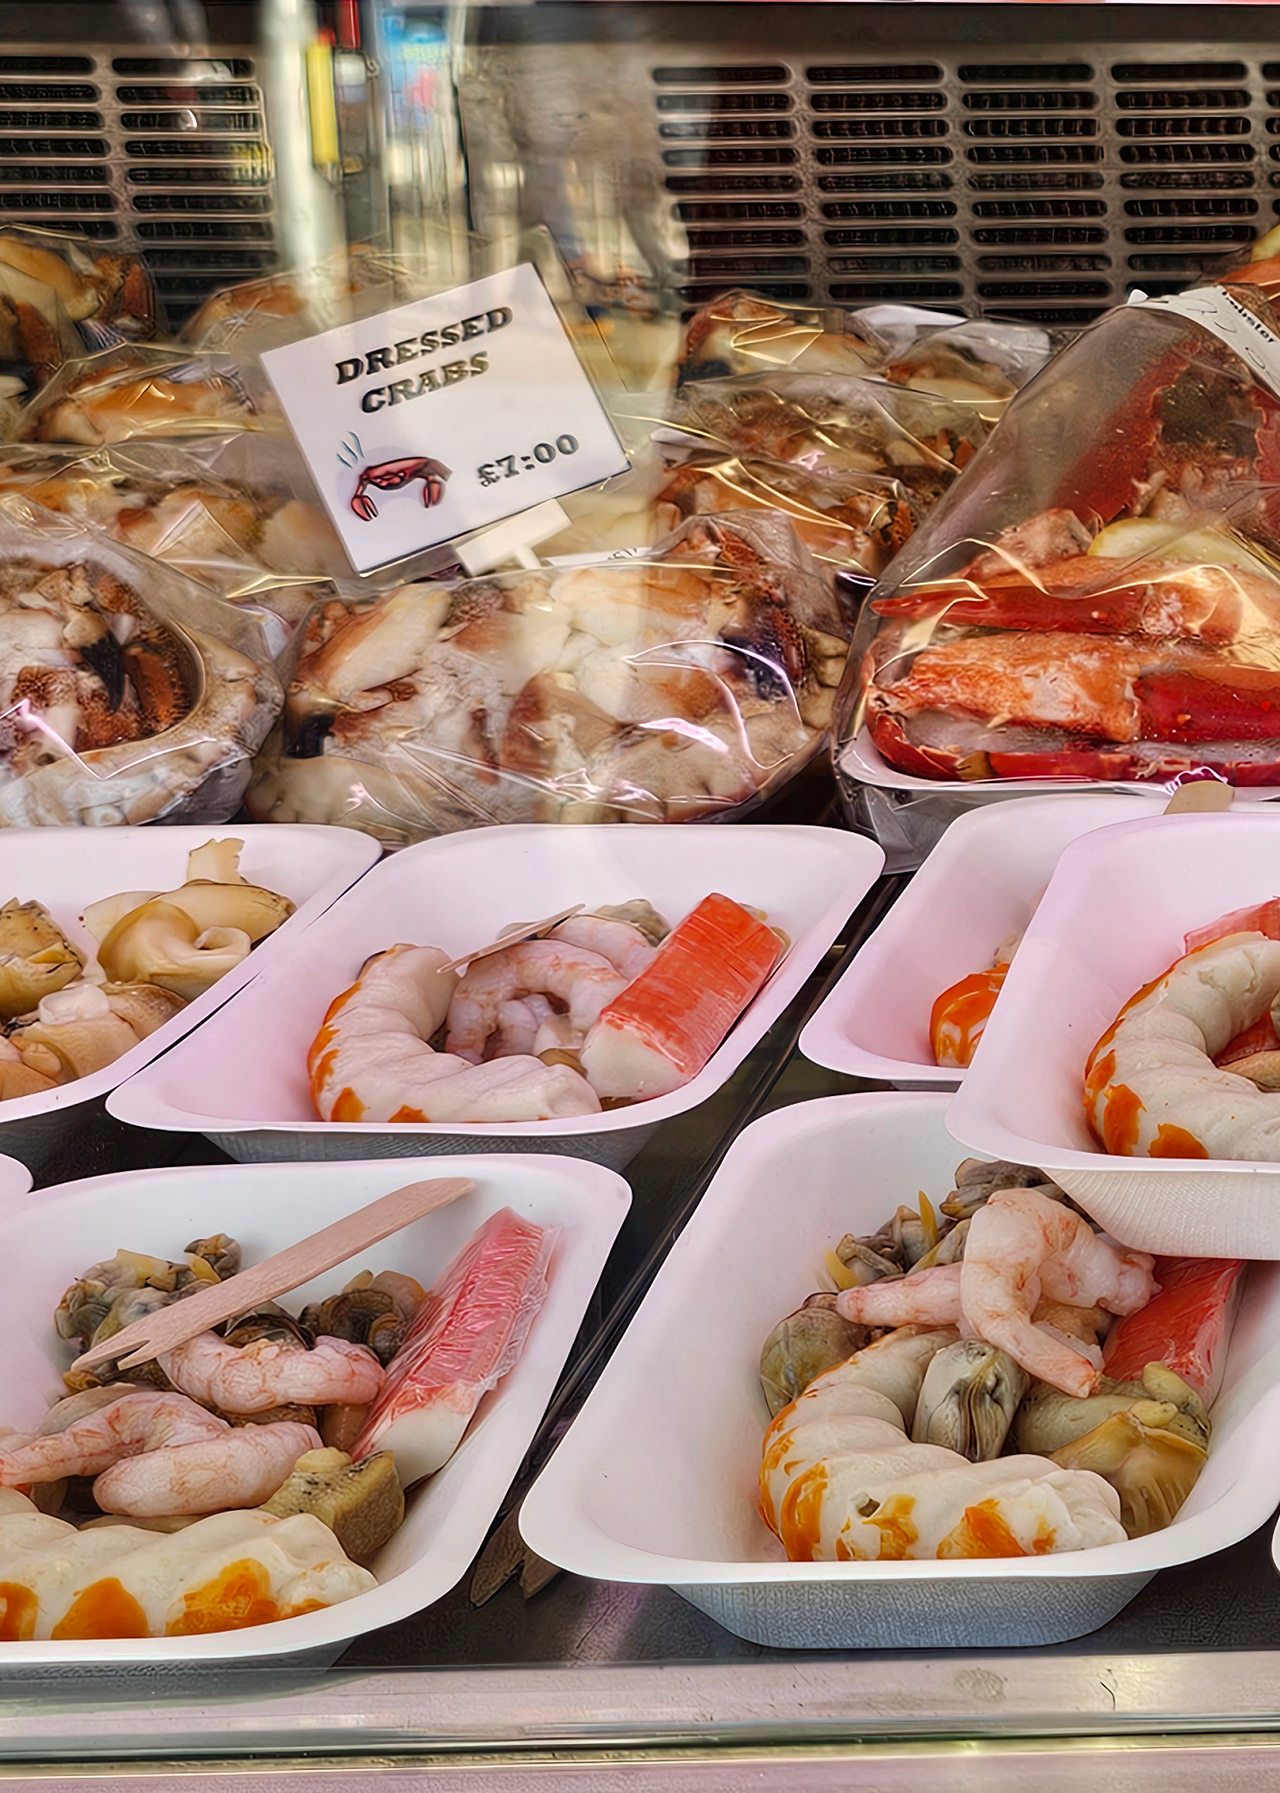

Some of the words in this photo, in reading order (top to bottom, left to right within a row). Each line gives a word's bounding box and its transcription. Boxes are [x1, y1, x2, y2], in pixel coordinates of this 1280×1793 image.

[334, 306, 514, 385] DRESSED
[360, 351, 491, 414] CRABS
[477, 434, 580, 487] £7:00
